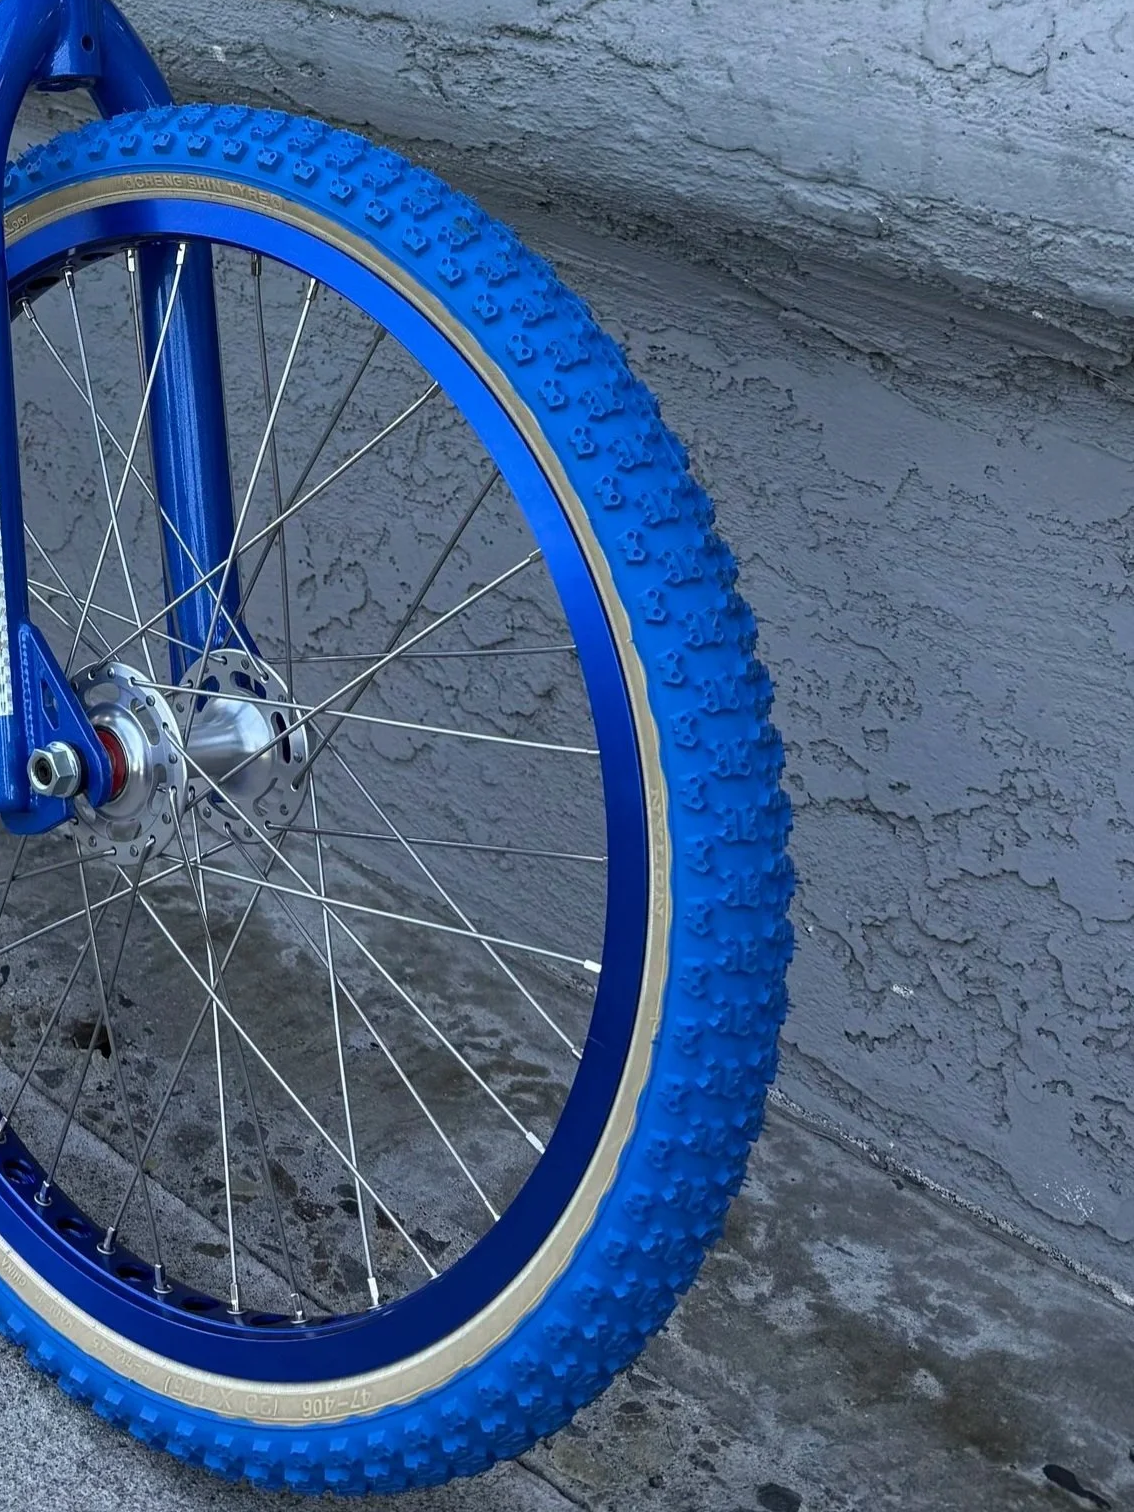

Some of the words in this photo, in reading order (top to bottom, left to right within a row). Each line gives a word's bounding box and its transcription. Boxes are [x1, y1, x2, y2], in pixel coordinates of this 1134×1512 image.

[133, 175, 183, 189] CHENG
[188, 177, 223, 192] SHIN
[229, 182, 269, 204] TYRE
[301, 1389, 373, 1418] 47-406
